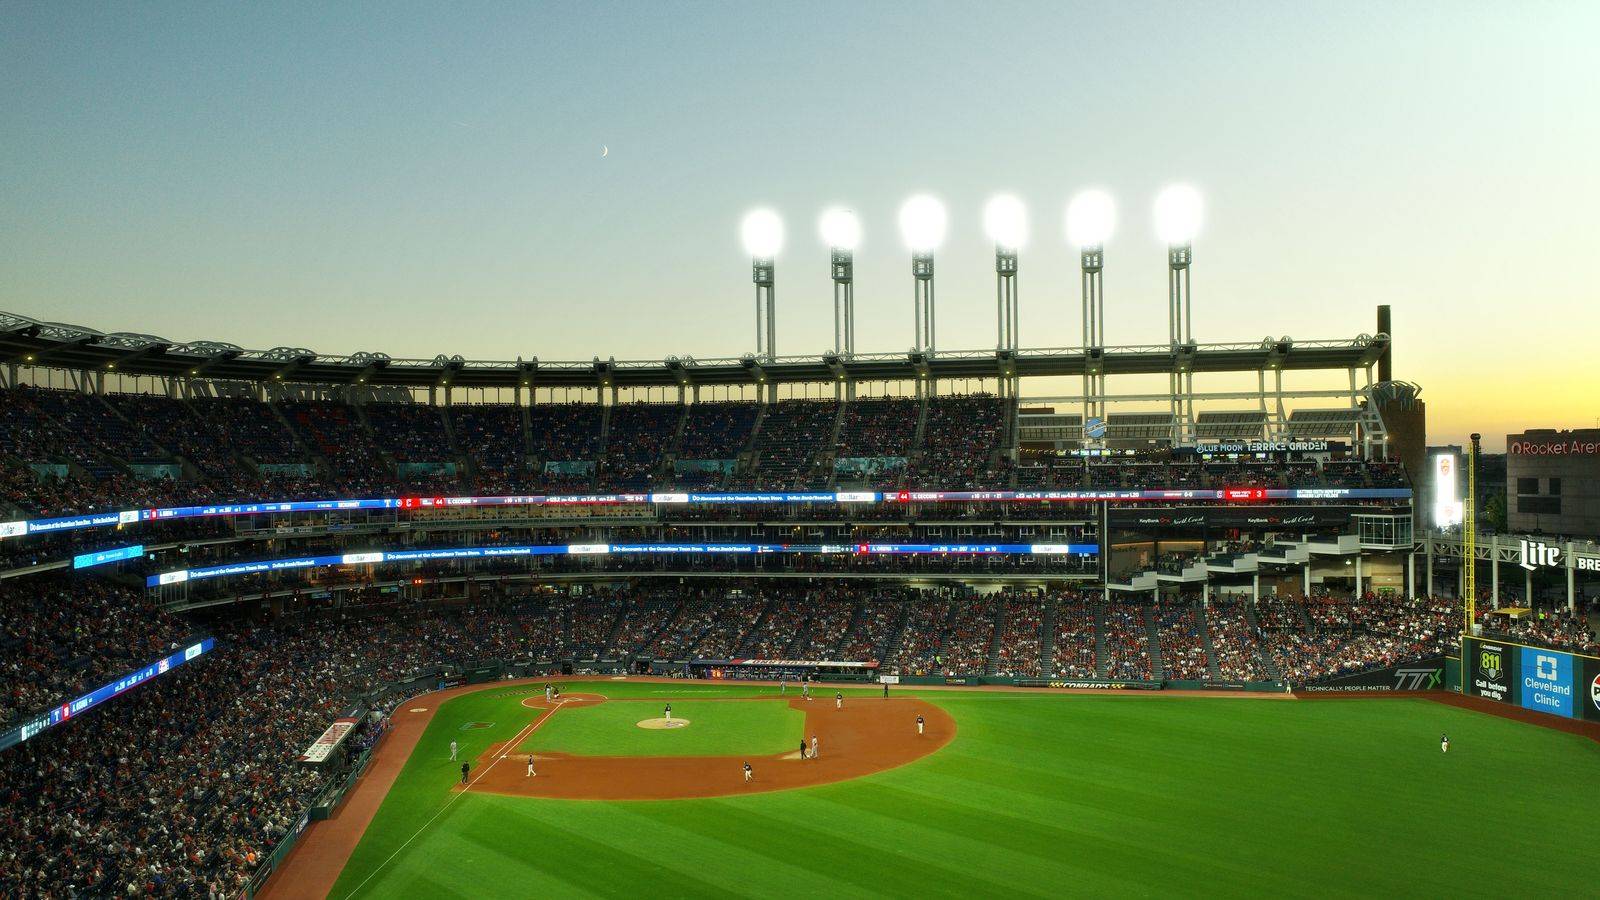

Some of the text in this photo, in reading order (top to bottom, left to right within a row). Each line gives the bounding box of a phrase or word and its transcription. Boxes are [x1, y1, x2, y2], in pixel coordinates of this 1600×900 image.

[1196, 441, 1328, 454] BLUE MOON TERRACE GARDEN
[1523, 442, 1568, 454] Rocket
[1520, 540, 1560, 571] Lite
[1578, 558, 1600, 571] BRE
[1482, 652, 1499, 670] 811
[1394, 669, 1443, 690] TTX
[1476, 679, 1507, 692] Call before
[1525, 677, 1570, 695] Cleveland
[1492, 691, 1502, 700] dig.
[1534, 693, 1560, 707] Clinic
